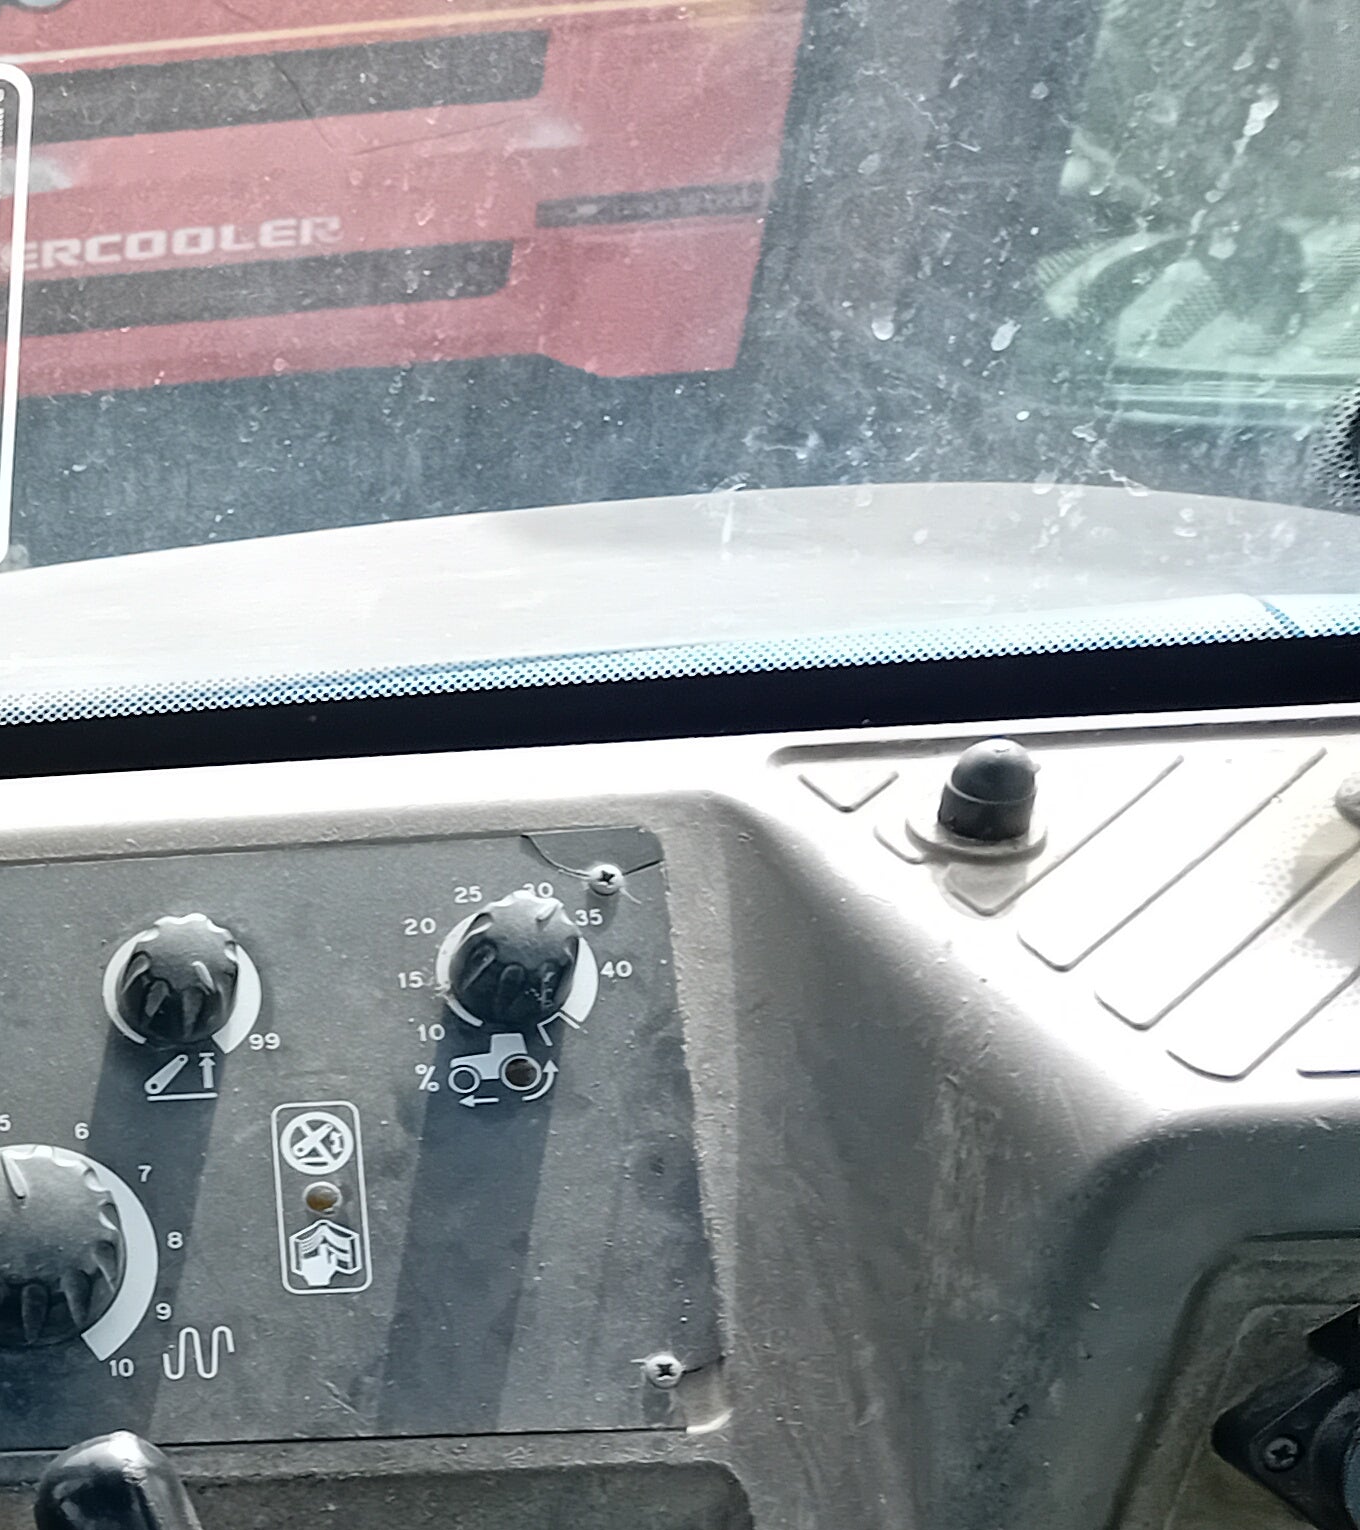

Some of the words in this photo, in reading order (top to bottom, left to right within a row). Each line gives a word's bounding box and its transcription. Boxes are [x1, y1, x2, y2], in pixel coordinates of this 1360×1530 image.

[453, 885, 483, 904] 25
[575, 908, 603, 926] 35
[403, 918, 436, 936] 20
[600, 960, 633, 978] 40
[398, 973, 424, 988] 15
[418, 1024, 446, 1041] 10
[249, 1033, 281, 1051] 99
[415, 1063, 440, 1092] %
[74, 1122, 89, 1140] 6
[138, 1164, 152, 1183] 7
[167, 1231, 183, 1249] 8
[156, 1302, 172, 1321] 9
[109, 1358, 134, 1378] 10
